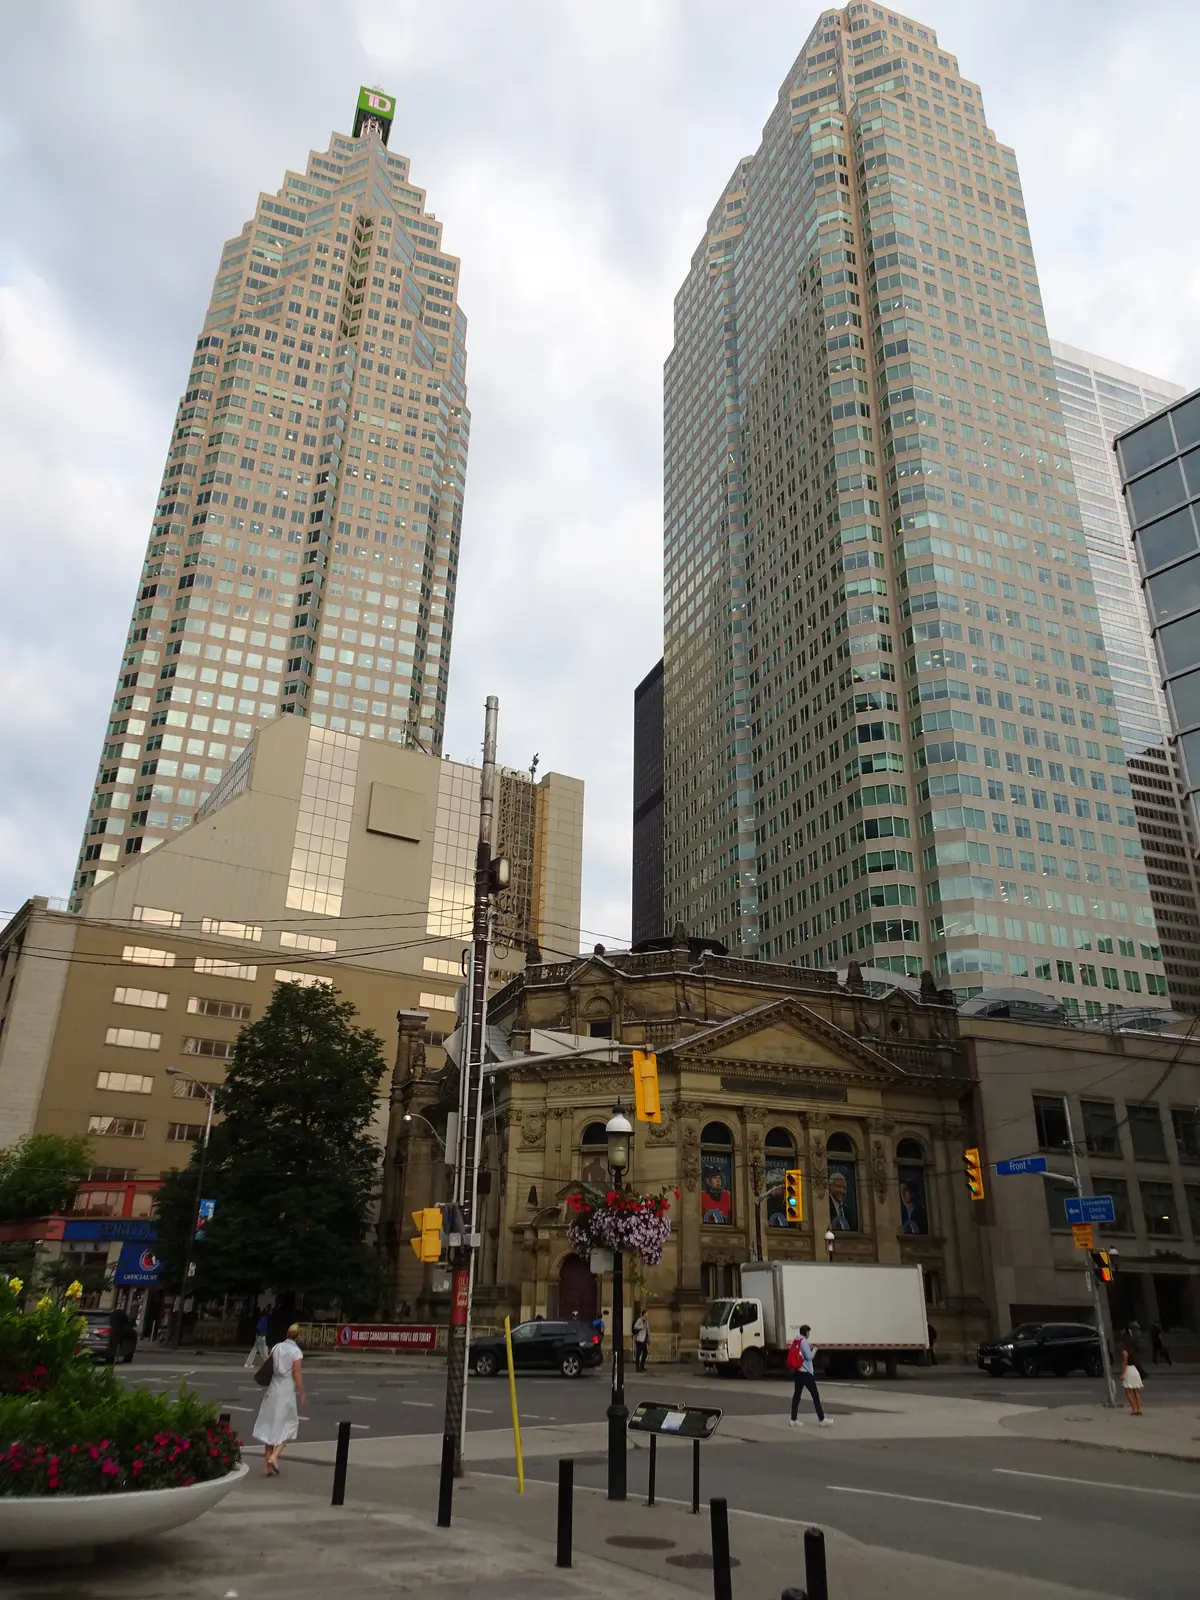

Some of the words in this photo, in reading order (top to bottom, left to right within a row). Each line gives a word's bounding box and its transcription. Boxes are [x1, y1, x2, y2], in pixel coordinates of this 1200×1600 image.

[363, 90, 391, 112] TD
[1008, 1161, 1027, 1171] Front
[351, 1331, 359, 1340] THE
[359, 1331, 369, 1340] MOST
[369, 1331, 388, 1341] CANADIAN
[388, 1332, 400, 1341] THING
[412, 1332, 418, 1342] DO
[418, 1332, 432, 1342] TODAY
